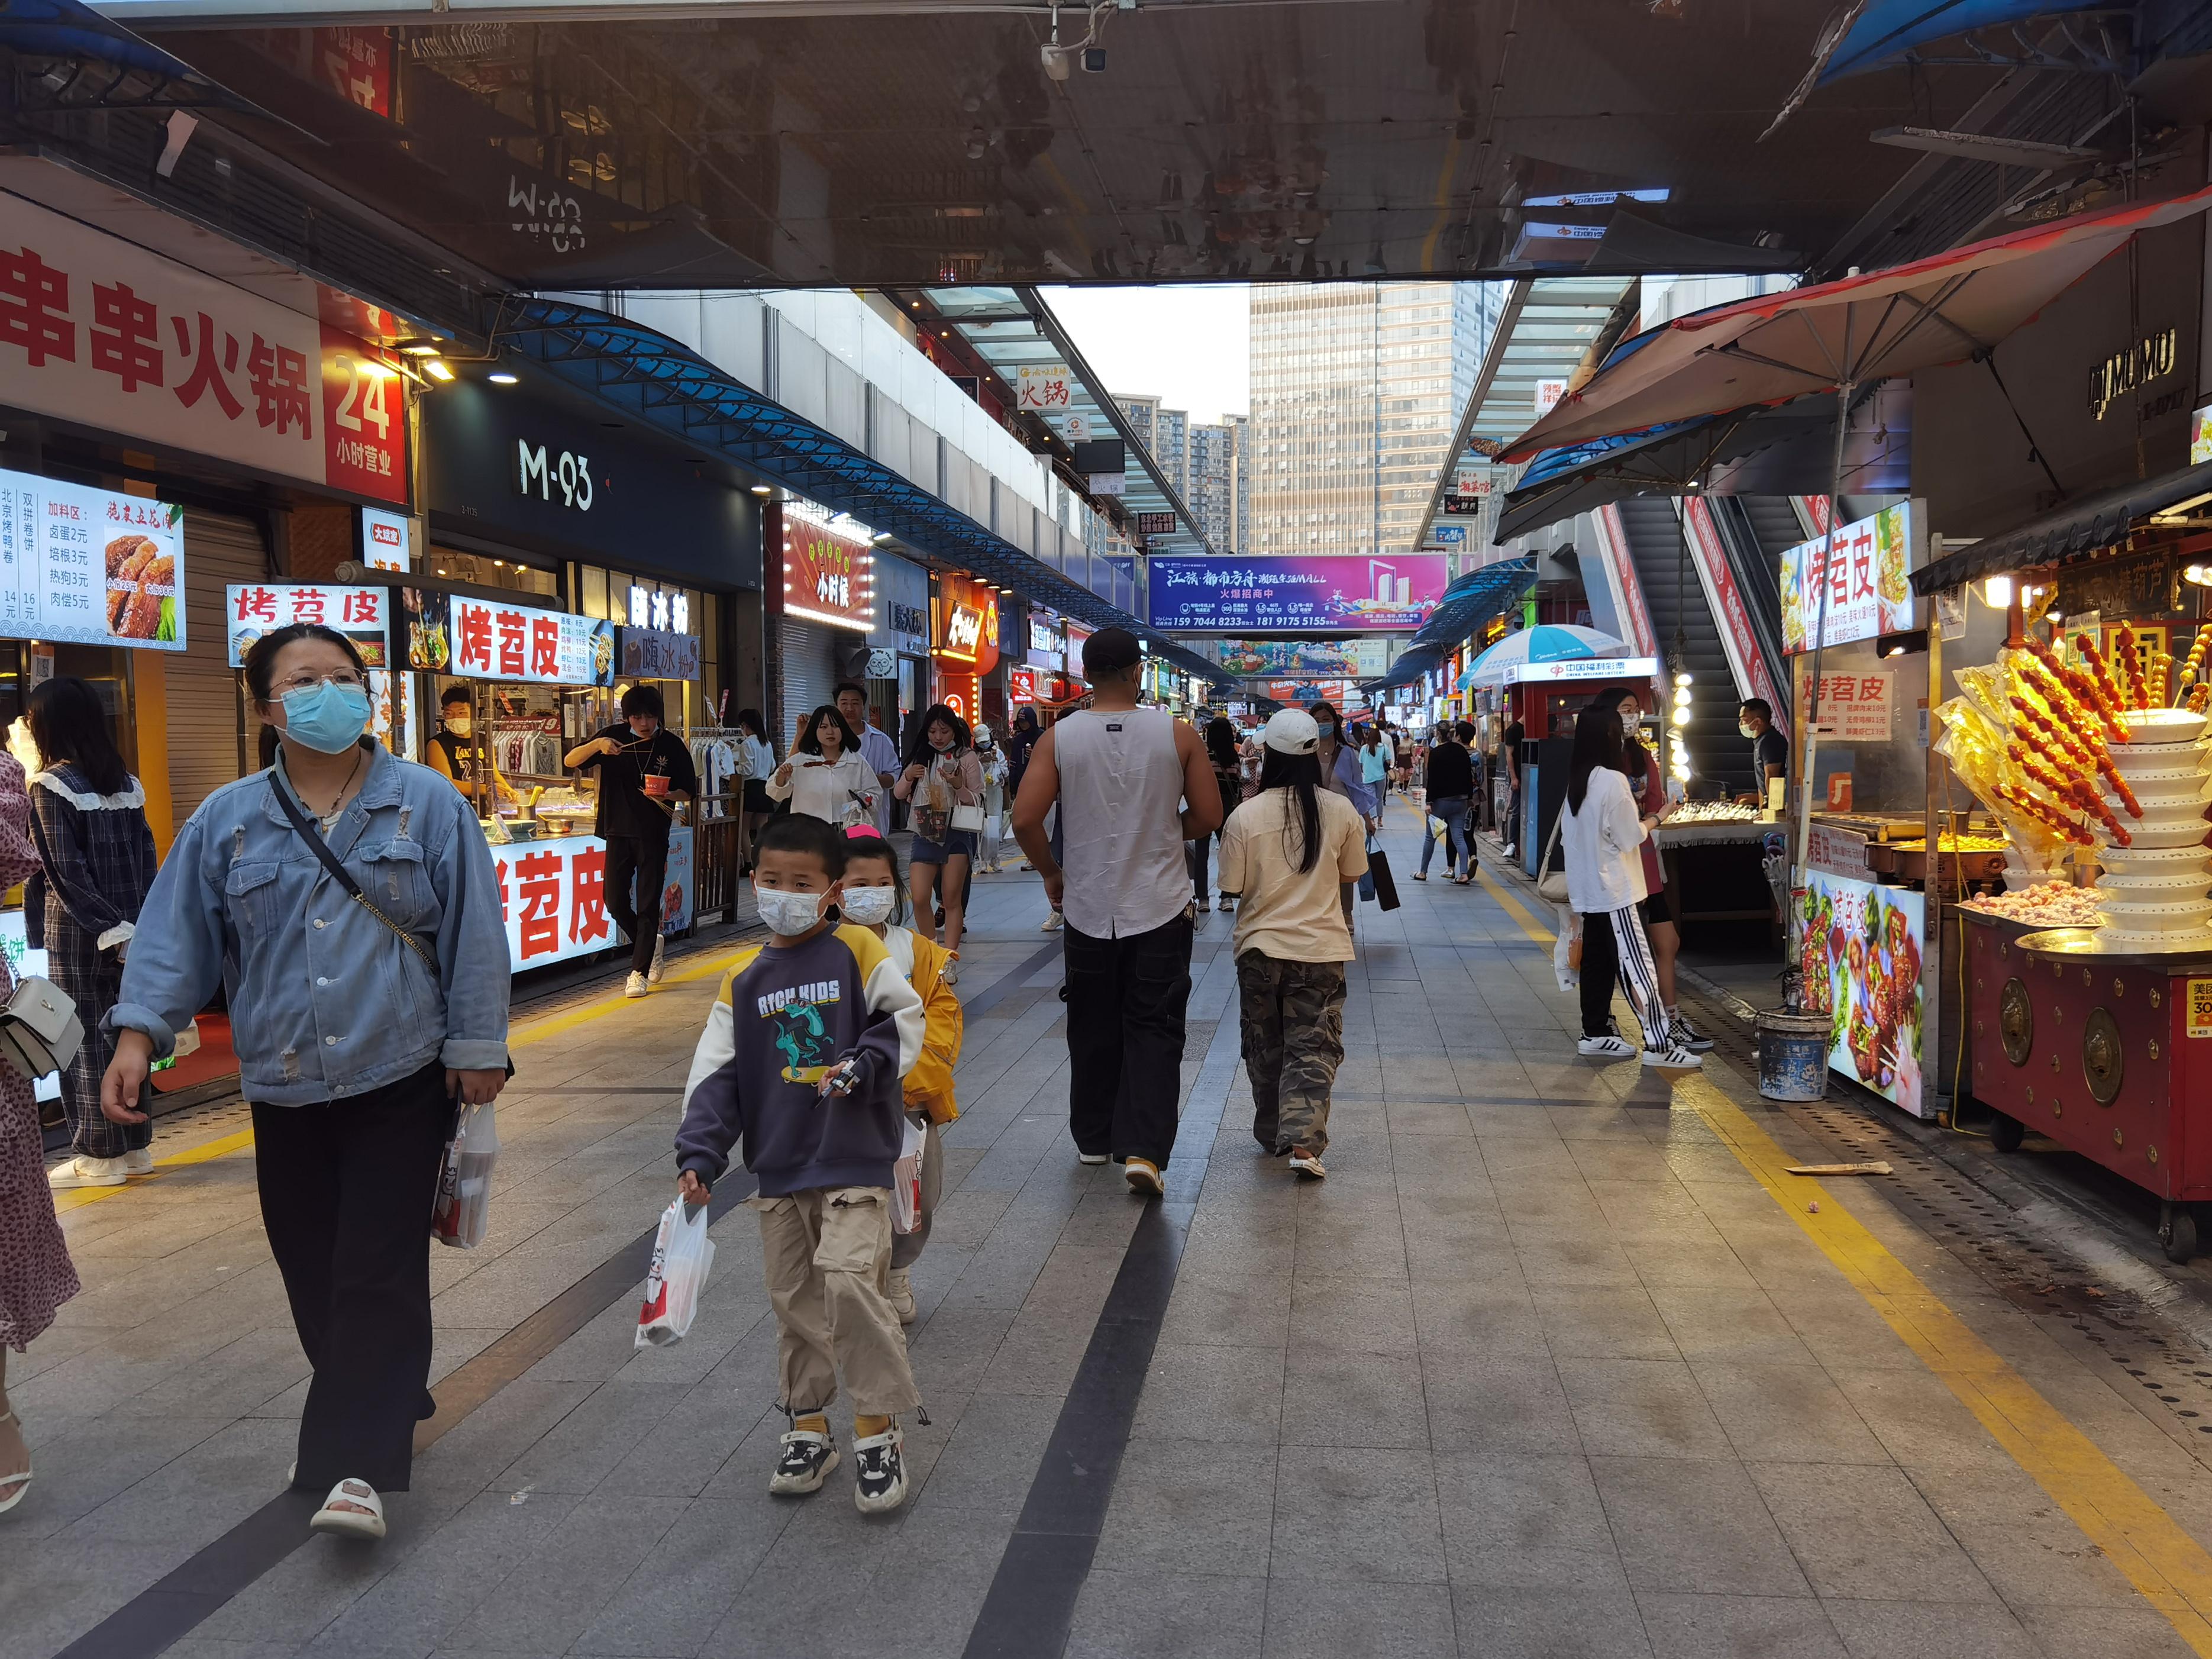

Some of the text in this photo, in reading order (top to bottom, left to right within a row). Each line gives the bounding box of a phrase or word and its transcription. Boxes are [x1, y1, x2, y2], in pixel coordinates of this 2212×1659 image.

[0, 246, 312, 440] 串串火锅
[335, 355, 390, 440] 24
[1019, 379, 1070, 406] 火锅
[336, 437, 392, 477] 小时营业
[1459, 480, 1490, 493] 湘菜馆
[2, 488, 14, 564] 北京烤鸭卷
[23, 492, 34, 553] 双拼卷饼
[106, 501, 172, 530] 脆皮五花肉
[49, 524, 88, 544] 卤蛋2元
[49, 546, 88, 566] 培根3元
[50, 569, 89, 588] 热狗3元
[107, 577, 137, 592] 小份25元
[146, 583, 175, 596] 大份38元
[817, 572, 850, 608] 小时候
[234, 587, 380, 624] 烤苕皮
[1220, 589, 1274, 599] 火爆招商中
[1174, 617, 1191, 626] 159
[1193, 617, 1216, 626] 7044
[1218, 617, 1242, 626] 8233
[1257, 617, 1273, 625] 181
[1276, 617, 1300, 625] 9175
[1302, 617, 1326, 625] 5155
[458, 603, 560, 677] 烤苕皮
[642, 635, 689, 679] 嗨冰粉
[1565, 661, 1625, 672] 中国福利彩票
[799, 979, 841, 1005] KIDS
